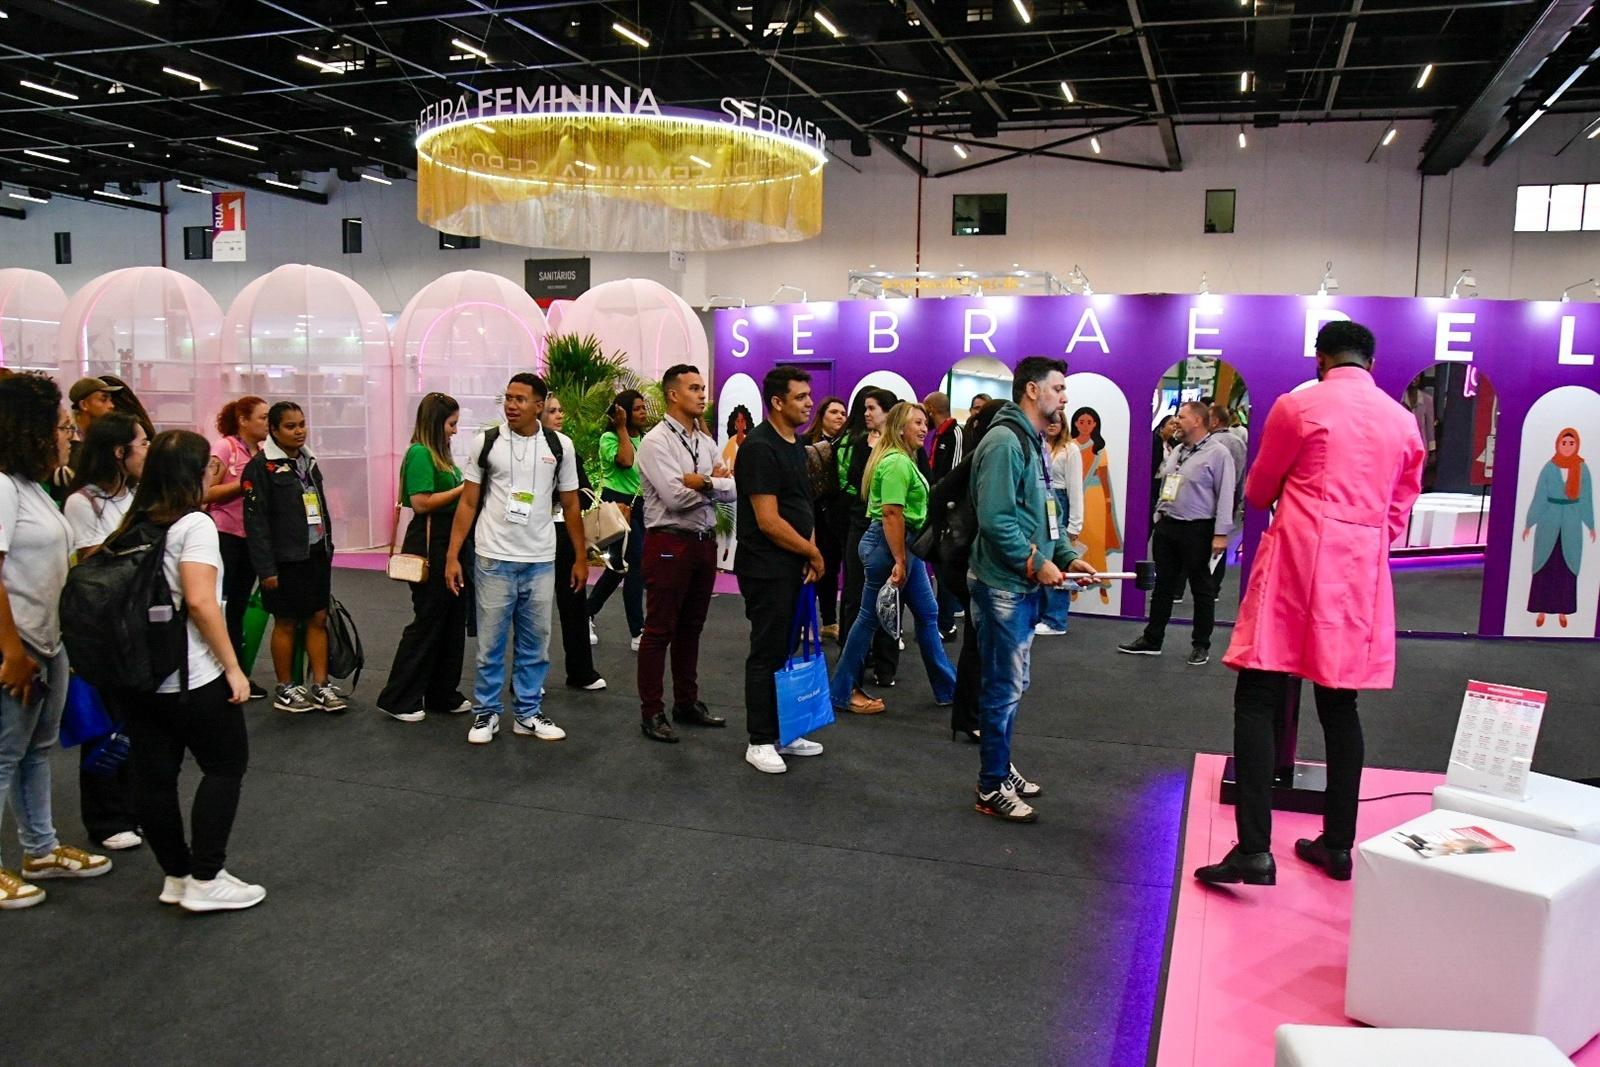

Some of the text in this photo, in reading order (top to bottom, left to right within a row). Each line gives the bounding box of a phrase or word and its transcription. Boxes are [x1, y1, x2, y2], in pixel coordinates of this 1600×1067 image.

[477, 84, 662, 119] FEMININA
[215, 198, 242, 233] RUA 1
[538, 269, 576, 281] SANITÁRIOS
